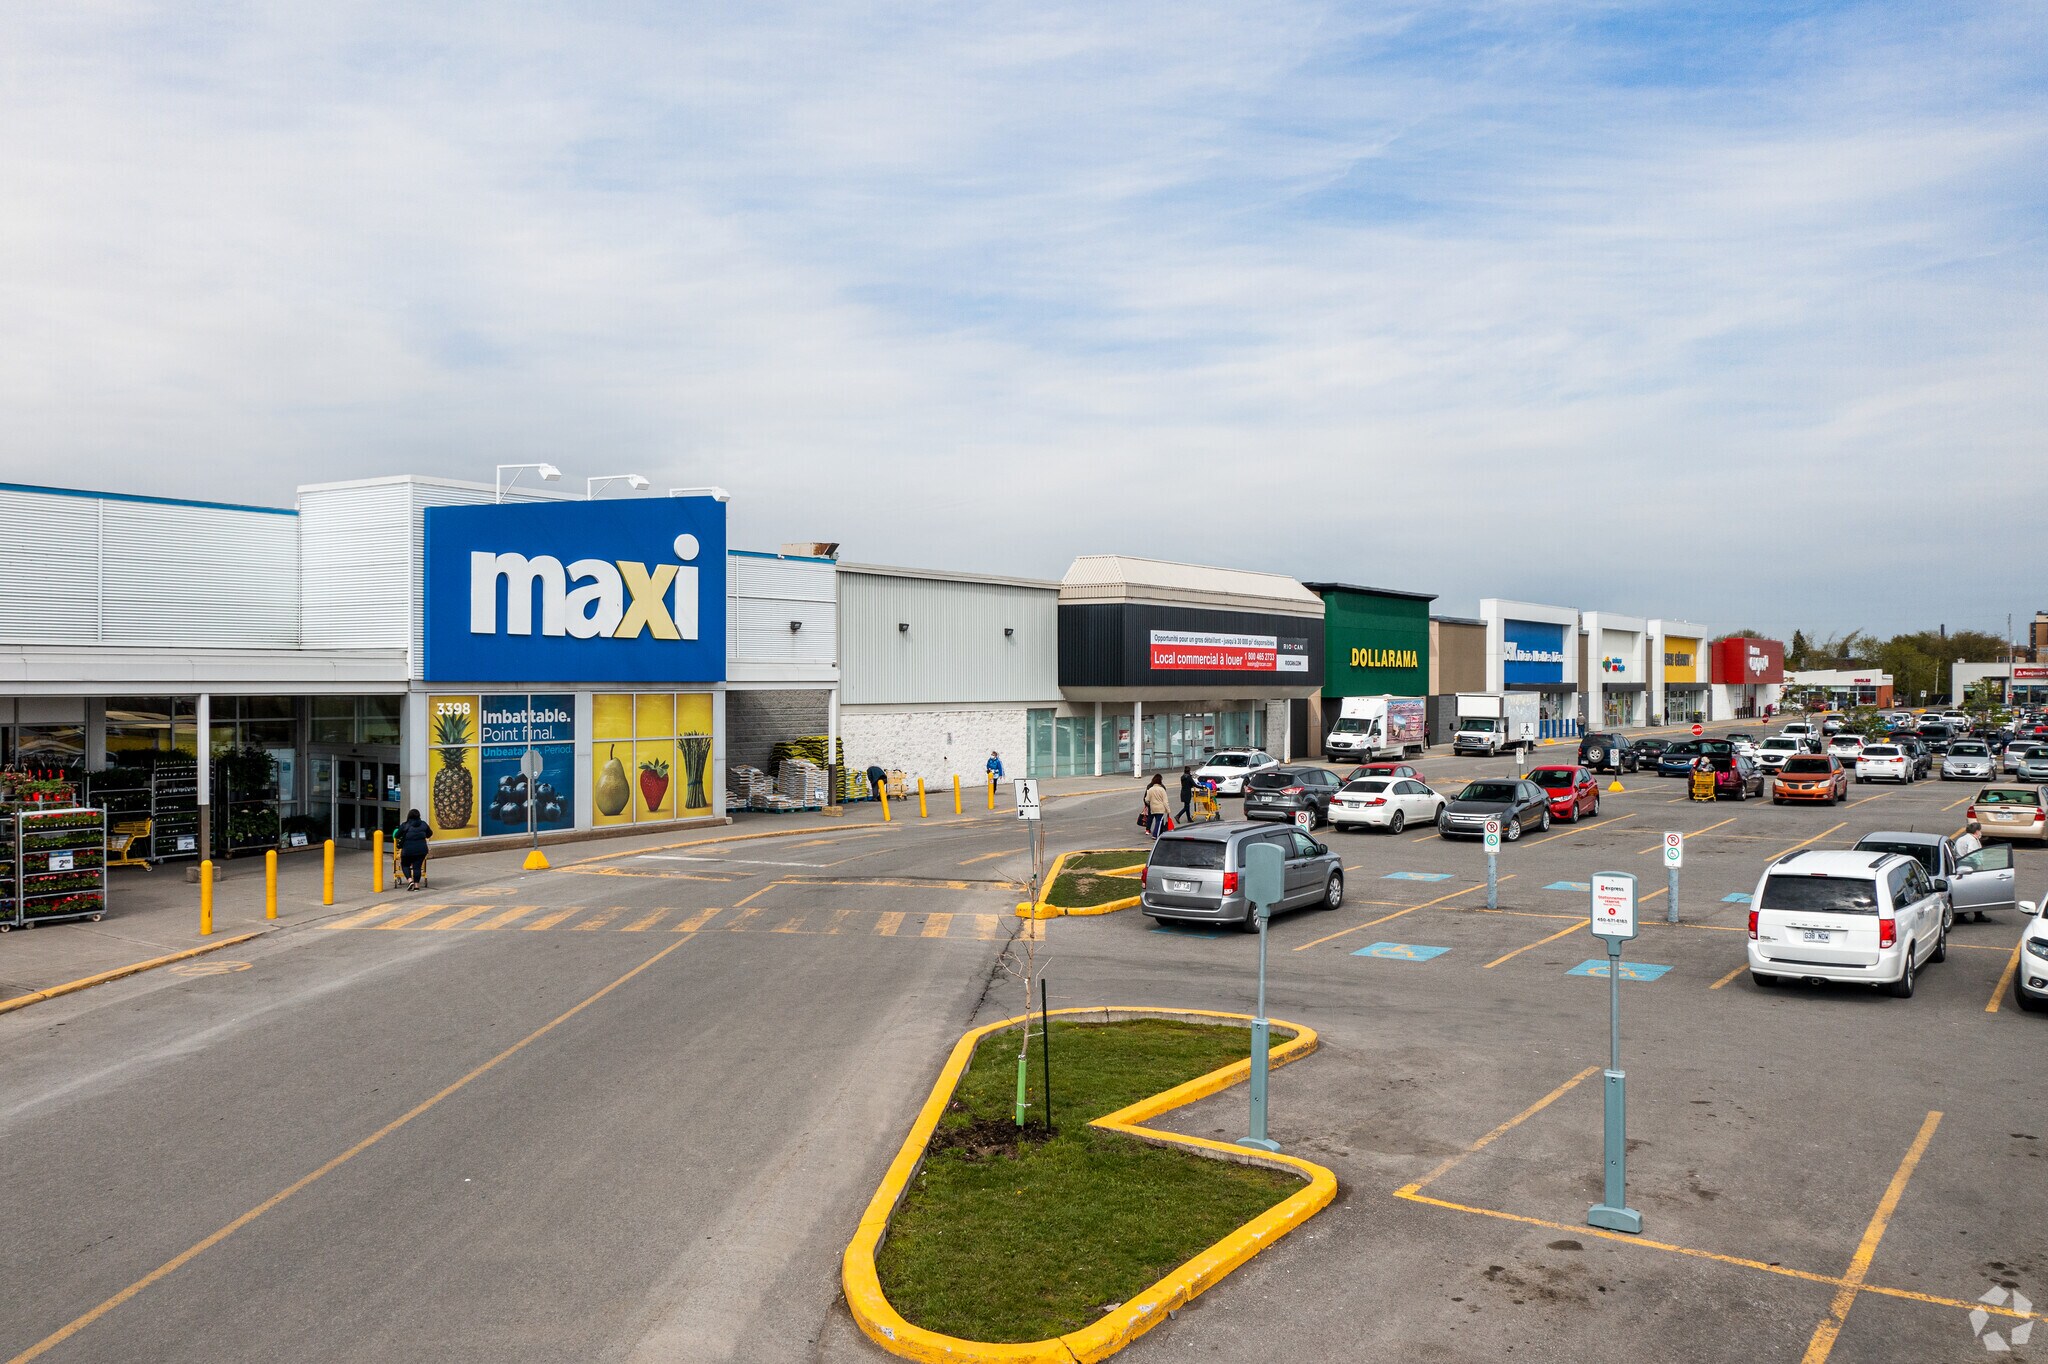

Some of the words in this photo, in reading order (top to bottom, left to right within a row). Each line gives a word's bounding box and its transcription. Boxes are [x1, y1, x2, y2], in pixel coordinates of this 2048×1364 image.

[470, 533, 700, 640] maxi
[1154, 651, 1176, 664] Local
[1177, 653, 1218, 665] commercial
[1219, 653, 1224, 665] à
[1225, 653, 1243, 665] louer
[1351, 648, 1418, 668] DOLLARAMA
[436, 702, 471, 715] 3398
[482, 709, 571, 724] Imbattable.
[482, 726, 518, 742] Point
[522, 725, 555, 741] final.
[544, 744, 573, 754] Period.
